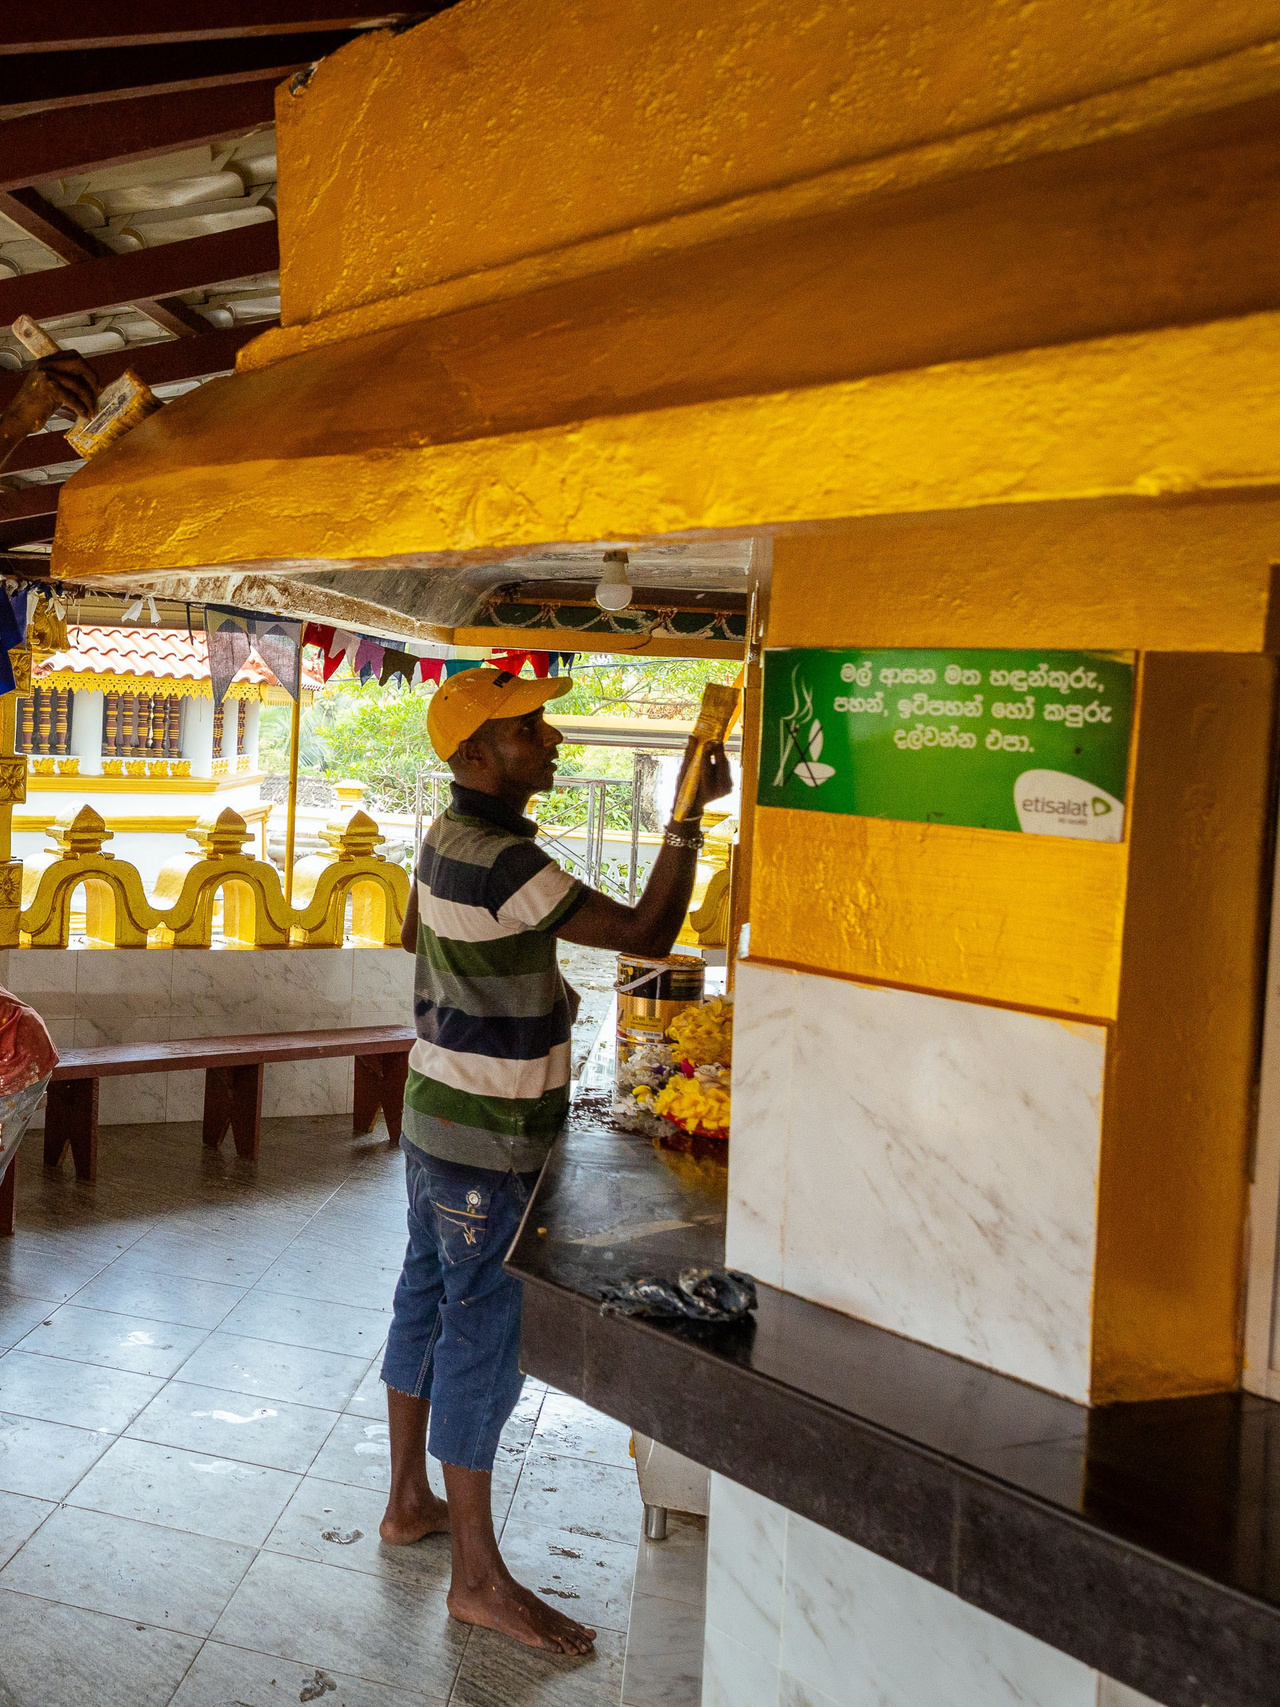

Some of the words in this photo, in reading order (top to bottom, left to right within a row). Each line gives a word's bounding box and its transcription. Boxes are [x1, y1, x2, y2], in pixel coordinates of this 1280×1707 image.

[840, 662, 873, 687] මල්
[879, 666, 937, 687] ආසන
[944, 664, 982, 686] මත
[833, 692, 889, 717] පහන්,
[991, 696, 1035, 720] හෝ
[1043, 700, 1113, 728] කපුරු
[893, 723, 977, 750] දල්වන්න
[1022, 797, 1088, 817] etisalat
